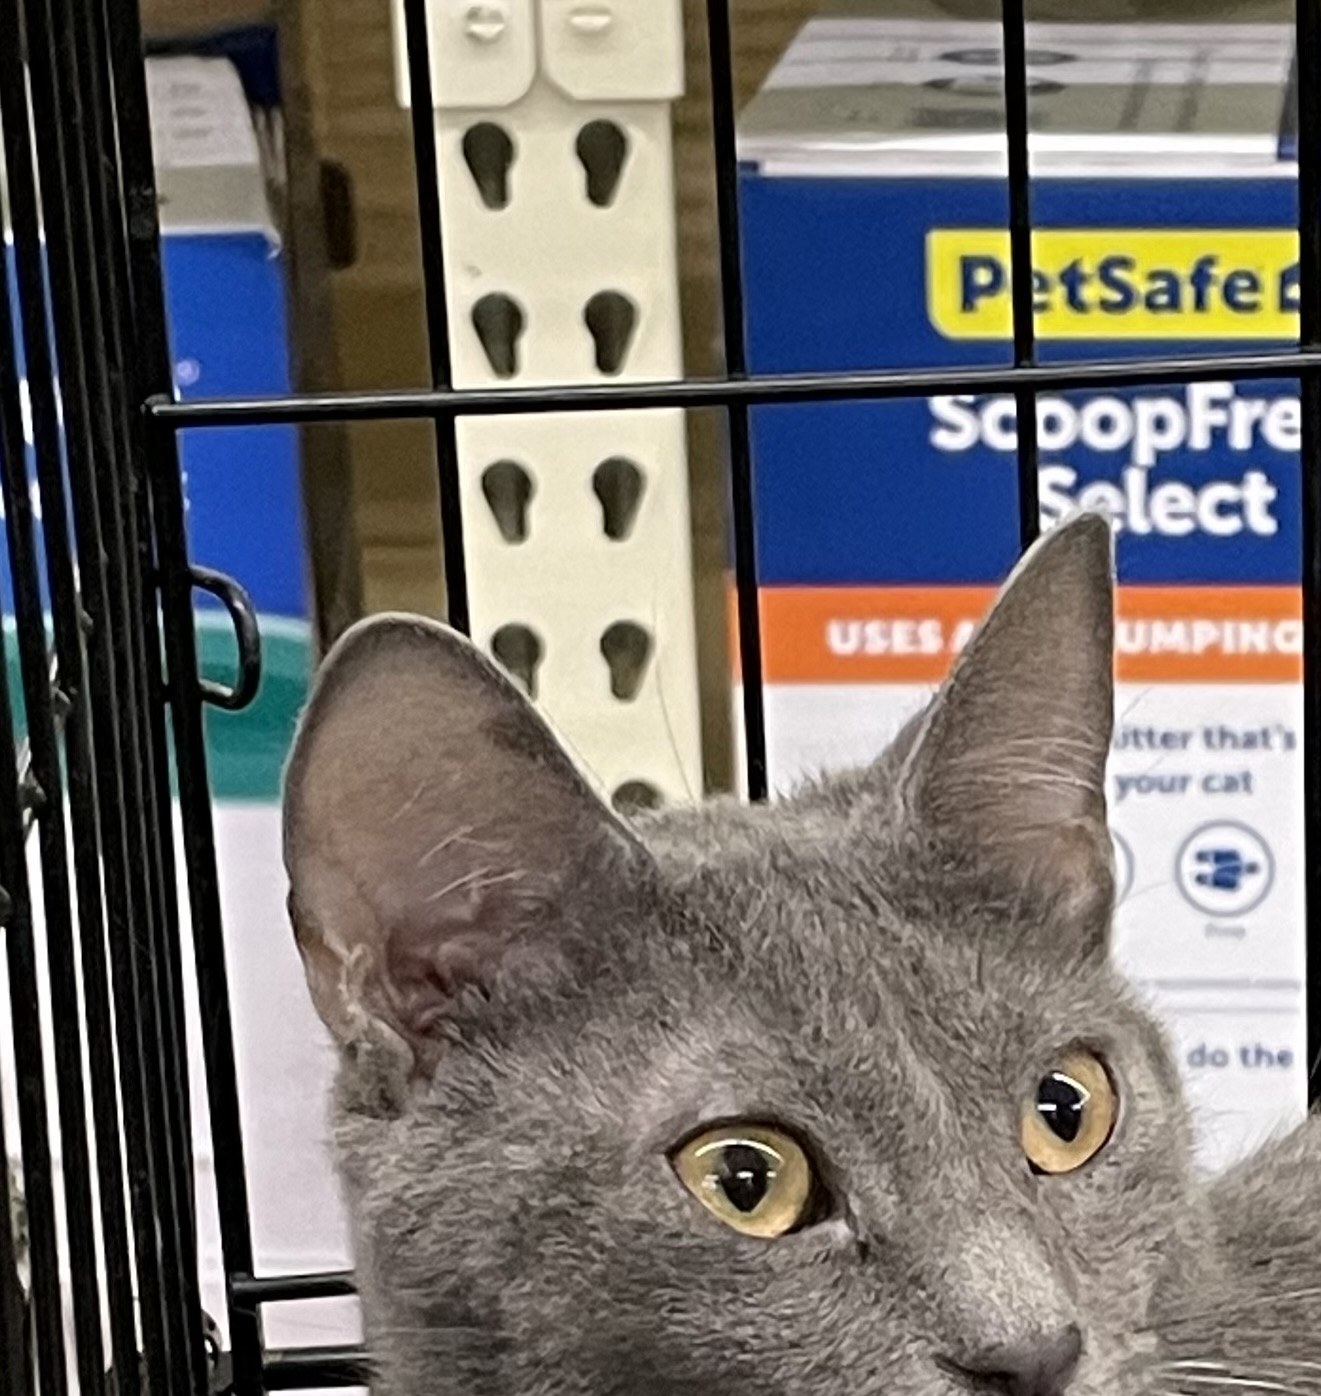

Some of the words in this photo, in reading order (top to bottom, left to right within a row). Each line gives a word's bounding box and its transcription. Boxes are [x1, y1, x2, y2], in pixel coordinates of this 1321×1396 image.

[959, 255, 1261, 314] PetSafe
[1038, 464, 1279, 536] Select
[827, 617, 943, 655] USES
[1114, 618, 1303, 655] UMPING
[1203, 723, 1297, 751] that's
[1114, 773, 1193, 803] your
[1201, 770, 1254, 794] cat
[1186, 1043, 1230, 1069] do
[1239, 1043, 1294, 1069] the
